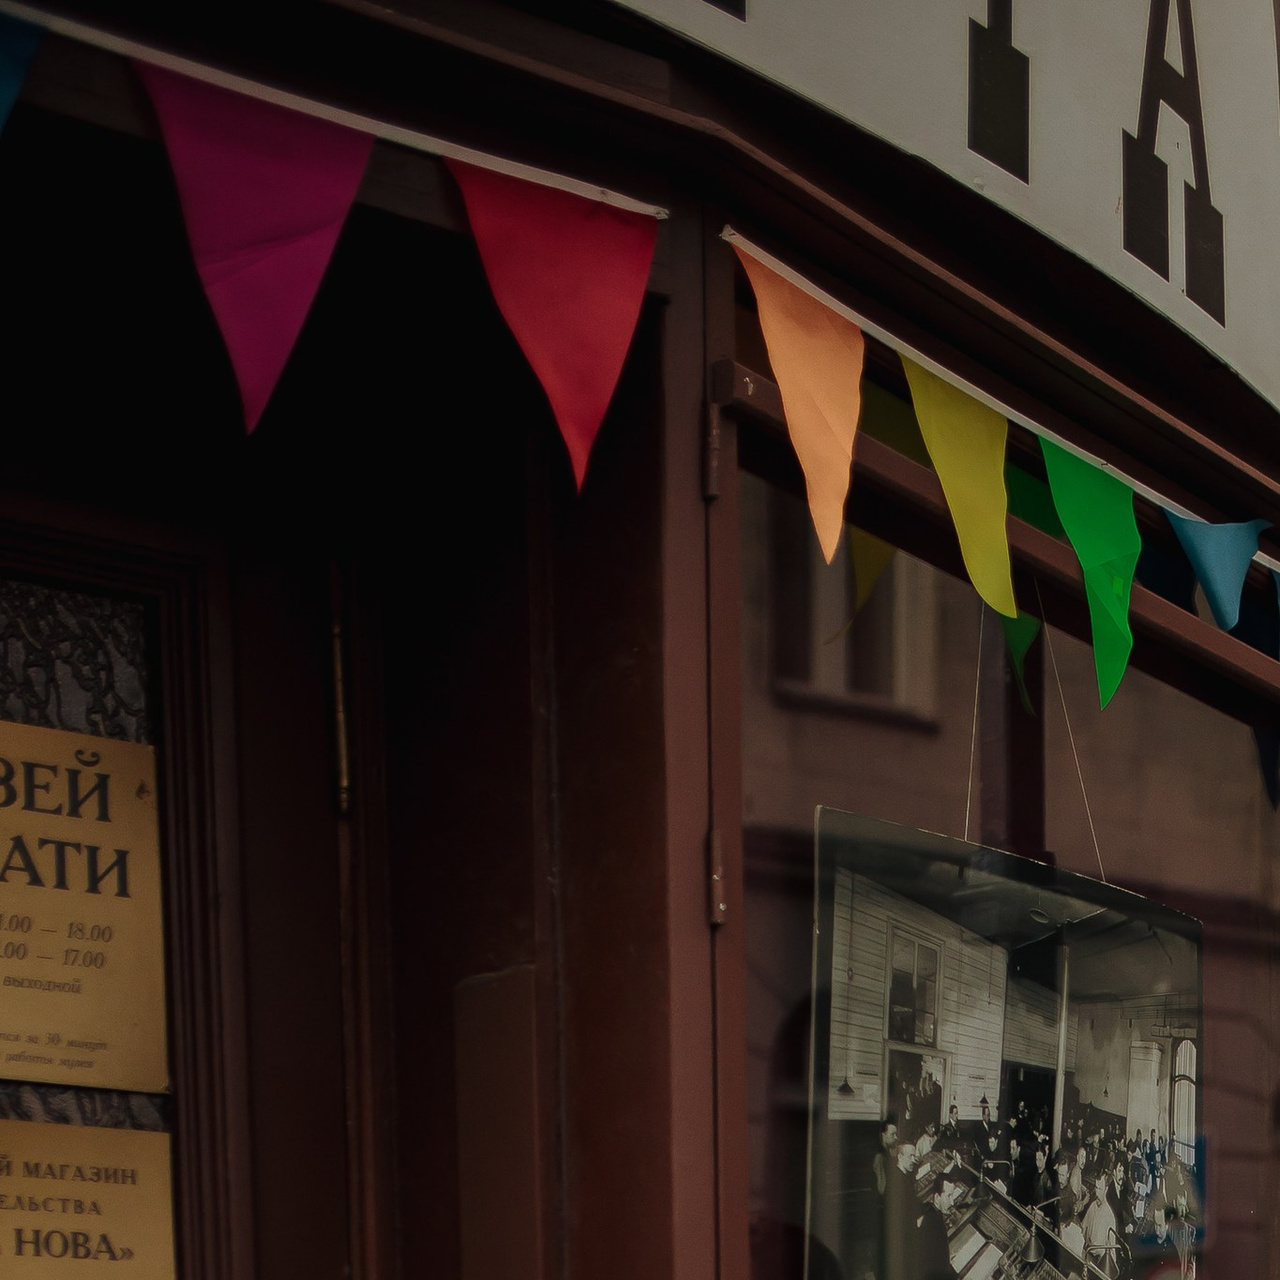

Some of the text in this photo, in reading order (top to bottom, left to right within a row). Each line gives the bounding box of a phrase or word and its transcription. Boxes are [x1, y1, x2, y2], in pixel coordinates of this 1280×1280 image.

[0, 835, 132, 899] АТИ
[67, 921, 112, 943] 18.00
[63, 948, 106, 969] 17.00
[22, 1161, 138, 1185] МАГАЗИН
[13, 1228, 134, 1261] НОВА»
